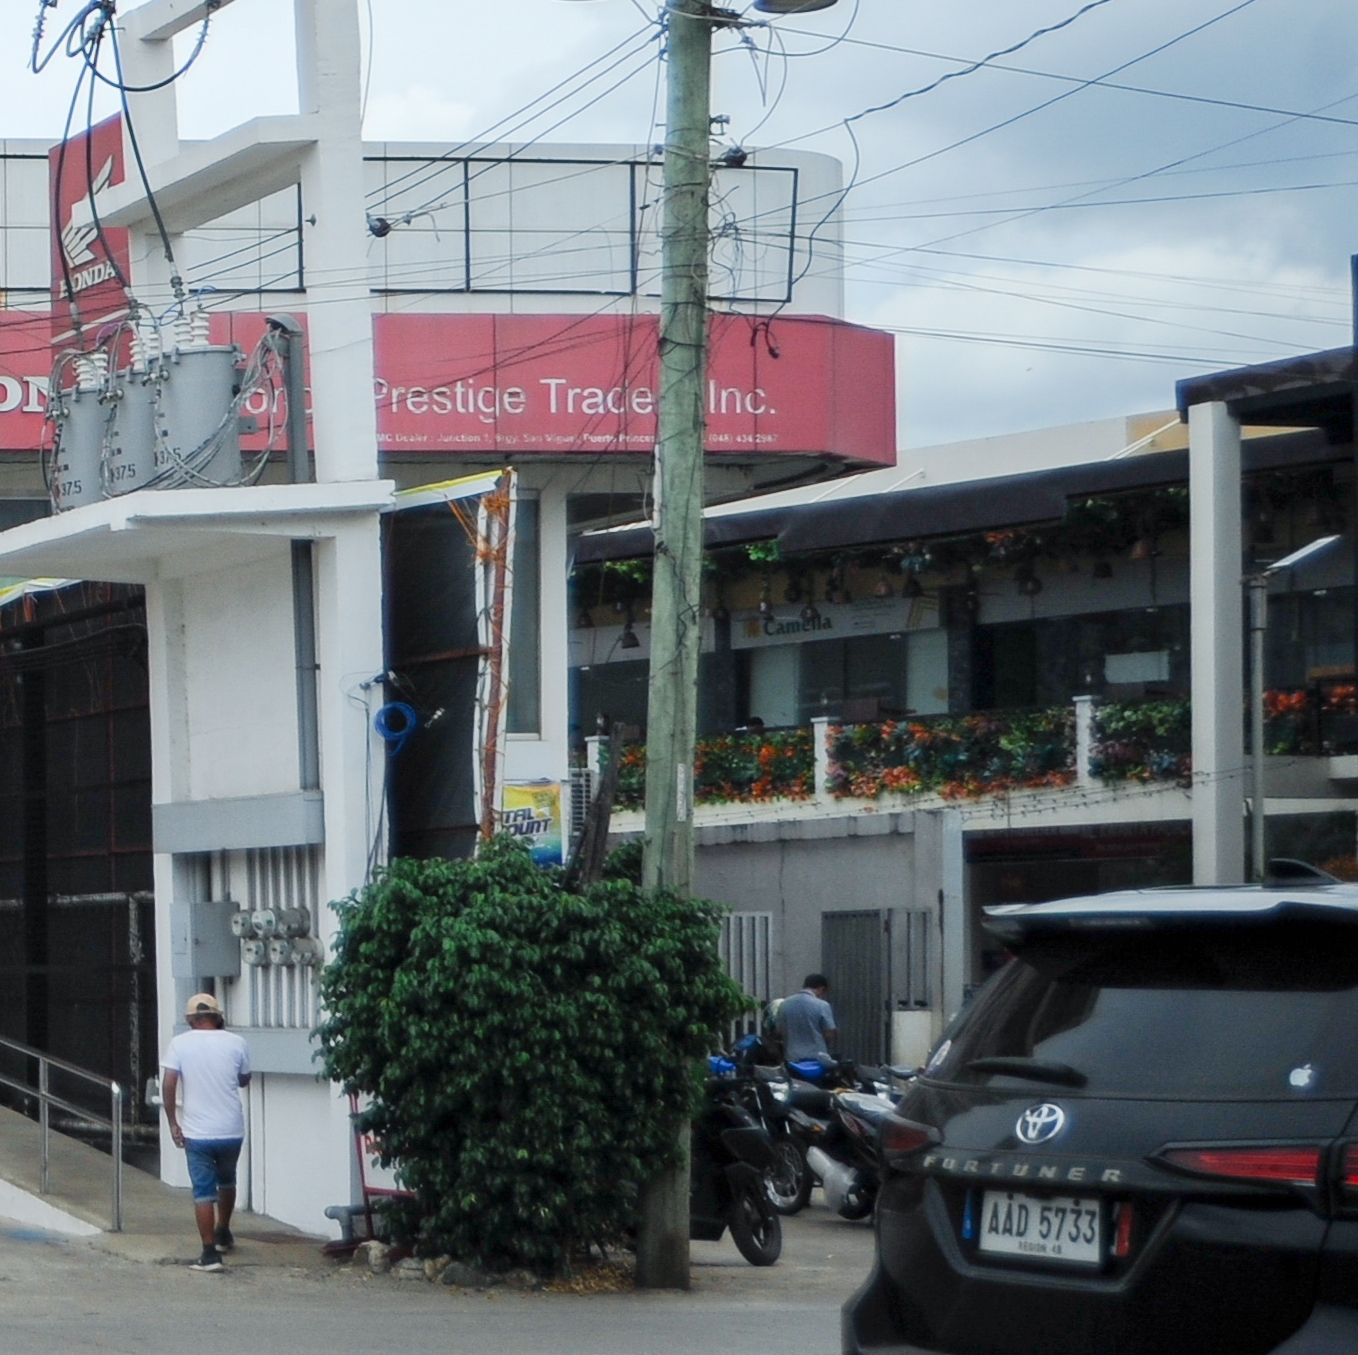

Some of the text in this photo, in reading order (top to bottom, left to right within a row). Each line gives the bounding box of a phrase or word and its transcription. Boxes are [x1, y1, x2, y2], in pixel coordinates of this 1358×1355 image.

[59, 260, 118, 300] HONDA
[539, 378, 654, 414] Trade
[708, 379, 776, 415] Inc.
[619, 433, 655, 442] Princes
[62, 480, 82, 496] 37.5
[922, 1155, 1122, 1182] FORTUNER
[987, 1201, 1029, 1238] AAD
[1039, 1206, 1097, 1245] 5733
